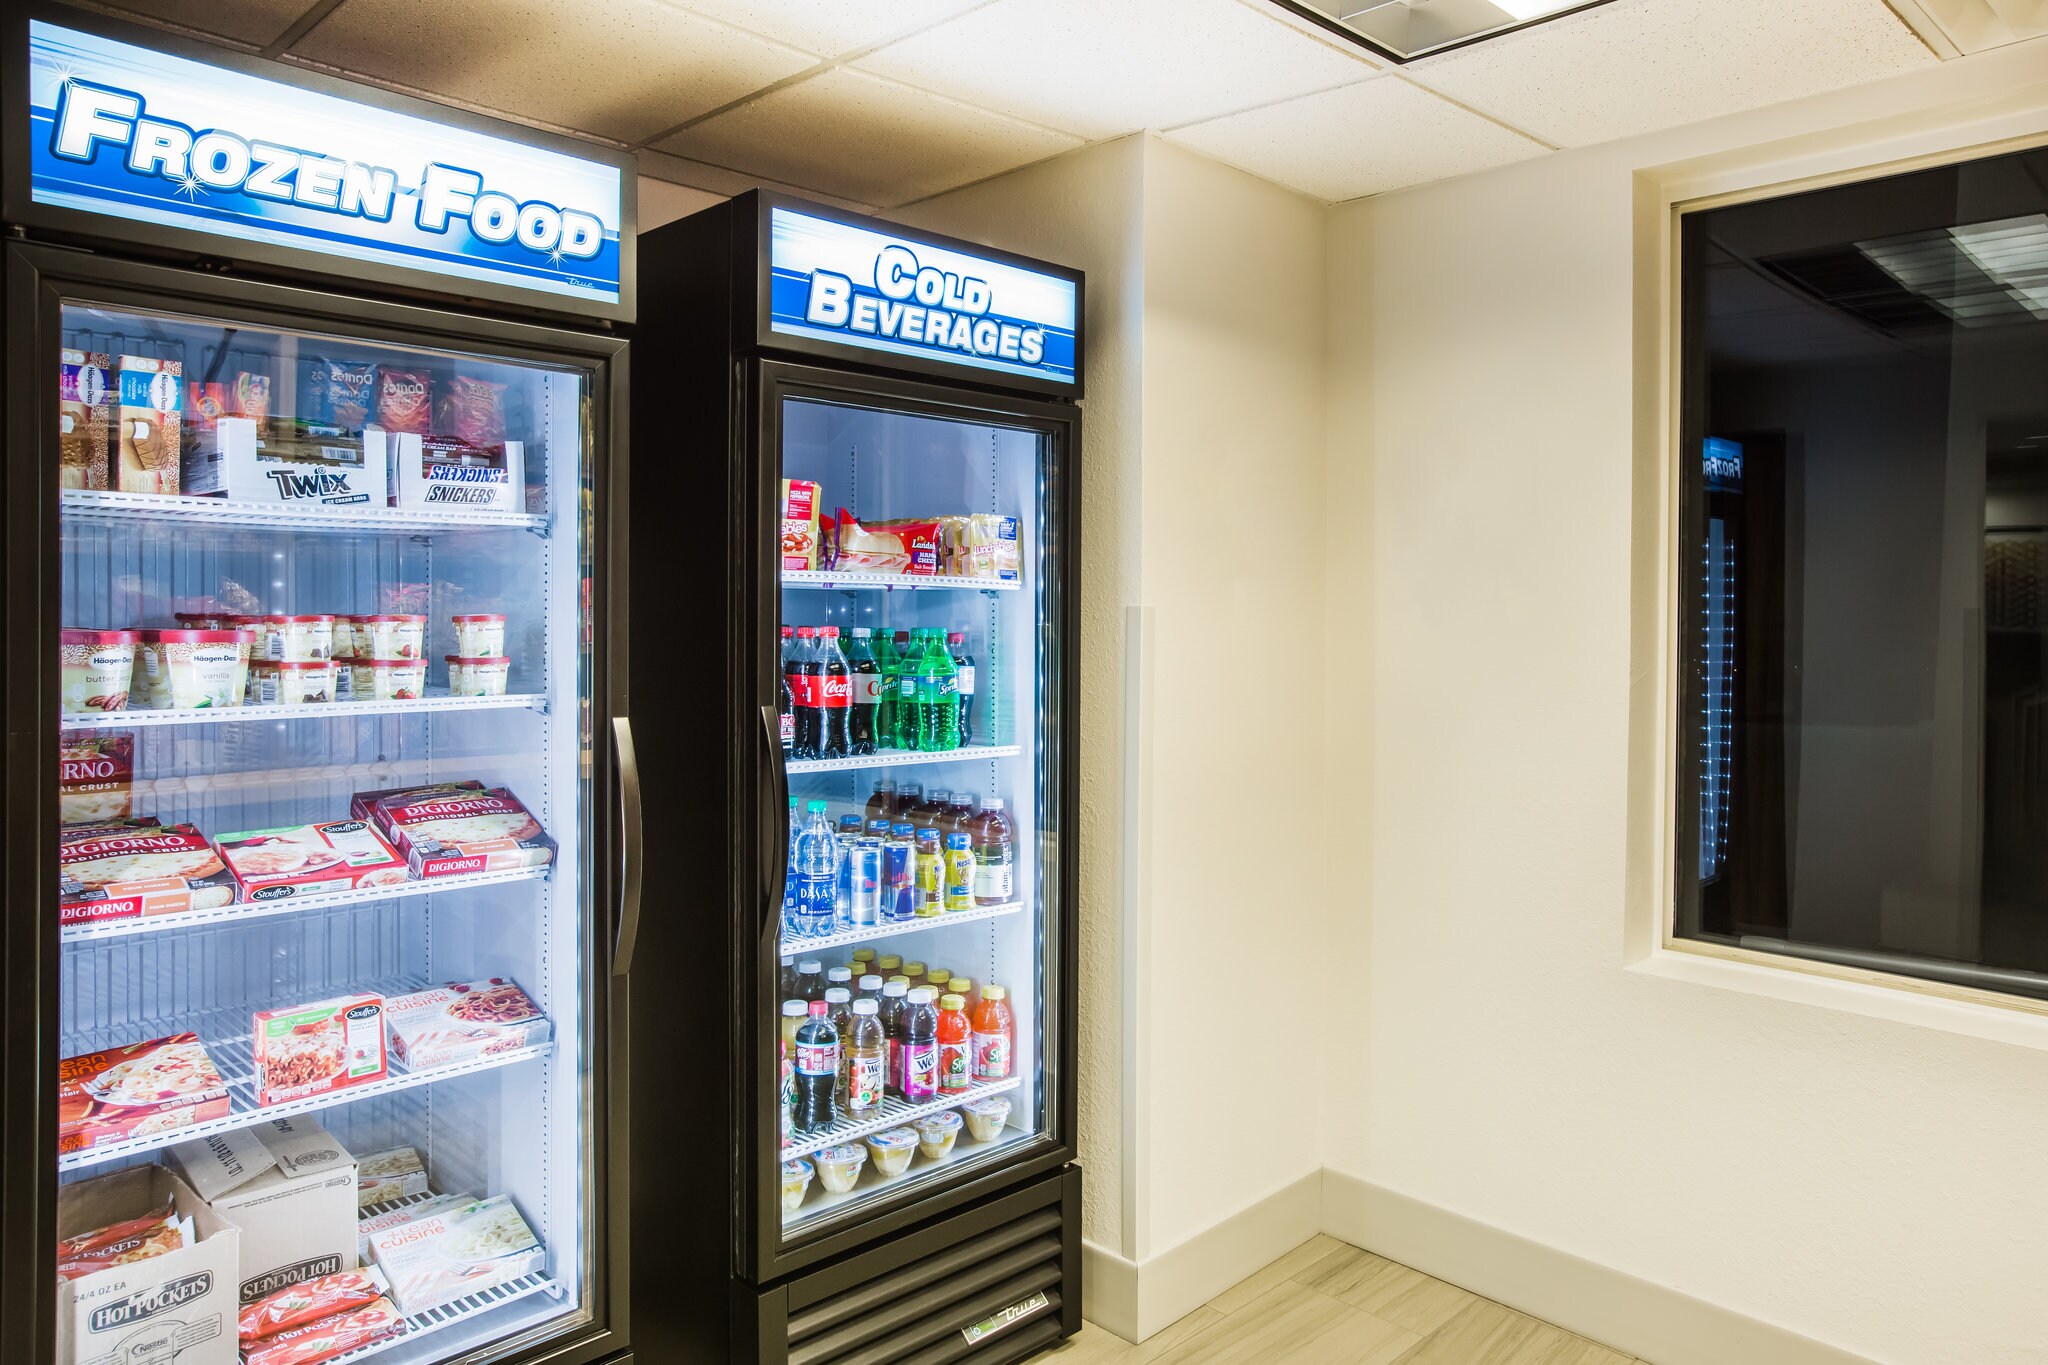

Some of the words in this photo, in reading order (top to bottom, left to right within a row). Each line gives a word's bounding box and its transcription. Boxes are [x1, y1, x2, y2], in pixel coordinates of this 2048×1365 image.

[52, 78, 398, 223] FROZEN
[418, 161, 605, 262] FOOD
[873, 244, 993, 316] COLD
[804, 267, 1046, 365] BEVERAGES
[429, 465, 501, 484] SNICKERS
[429, 486, 495, 504] SNICKERS
[79, 782, 119, 792] CRUST
[404, 799, 504, 817] DIGIORNO
[404, 811, 479, 824] TRADITIONAL
[152, 845, 196, 853] CRUST
[429, 859, 481, 873] DIGIORNO
[257, 886, 294, 900] Stouffer's
[61, 901, 134, 920] DIGIORNO
[349, 1006, 378, 1018] Stouffer's
[309, 1256, 337, 1277] HOT
[73, 1288, 96, 1304] 24/4
[98, 1284, 112, 1296] OZ
[114, 1281, 127, 1291] EA
[242, 1269, 307, 1301] POCKETS
[96, 1300, 137, 1329] HOT
[135, 1273, 210, 1311] POCKETS
[997, 1299, 1043, 1321] true
